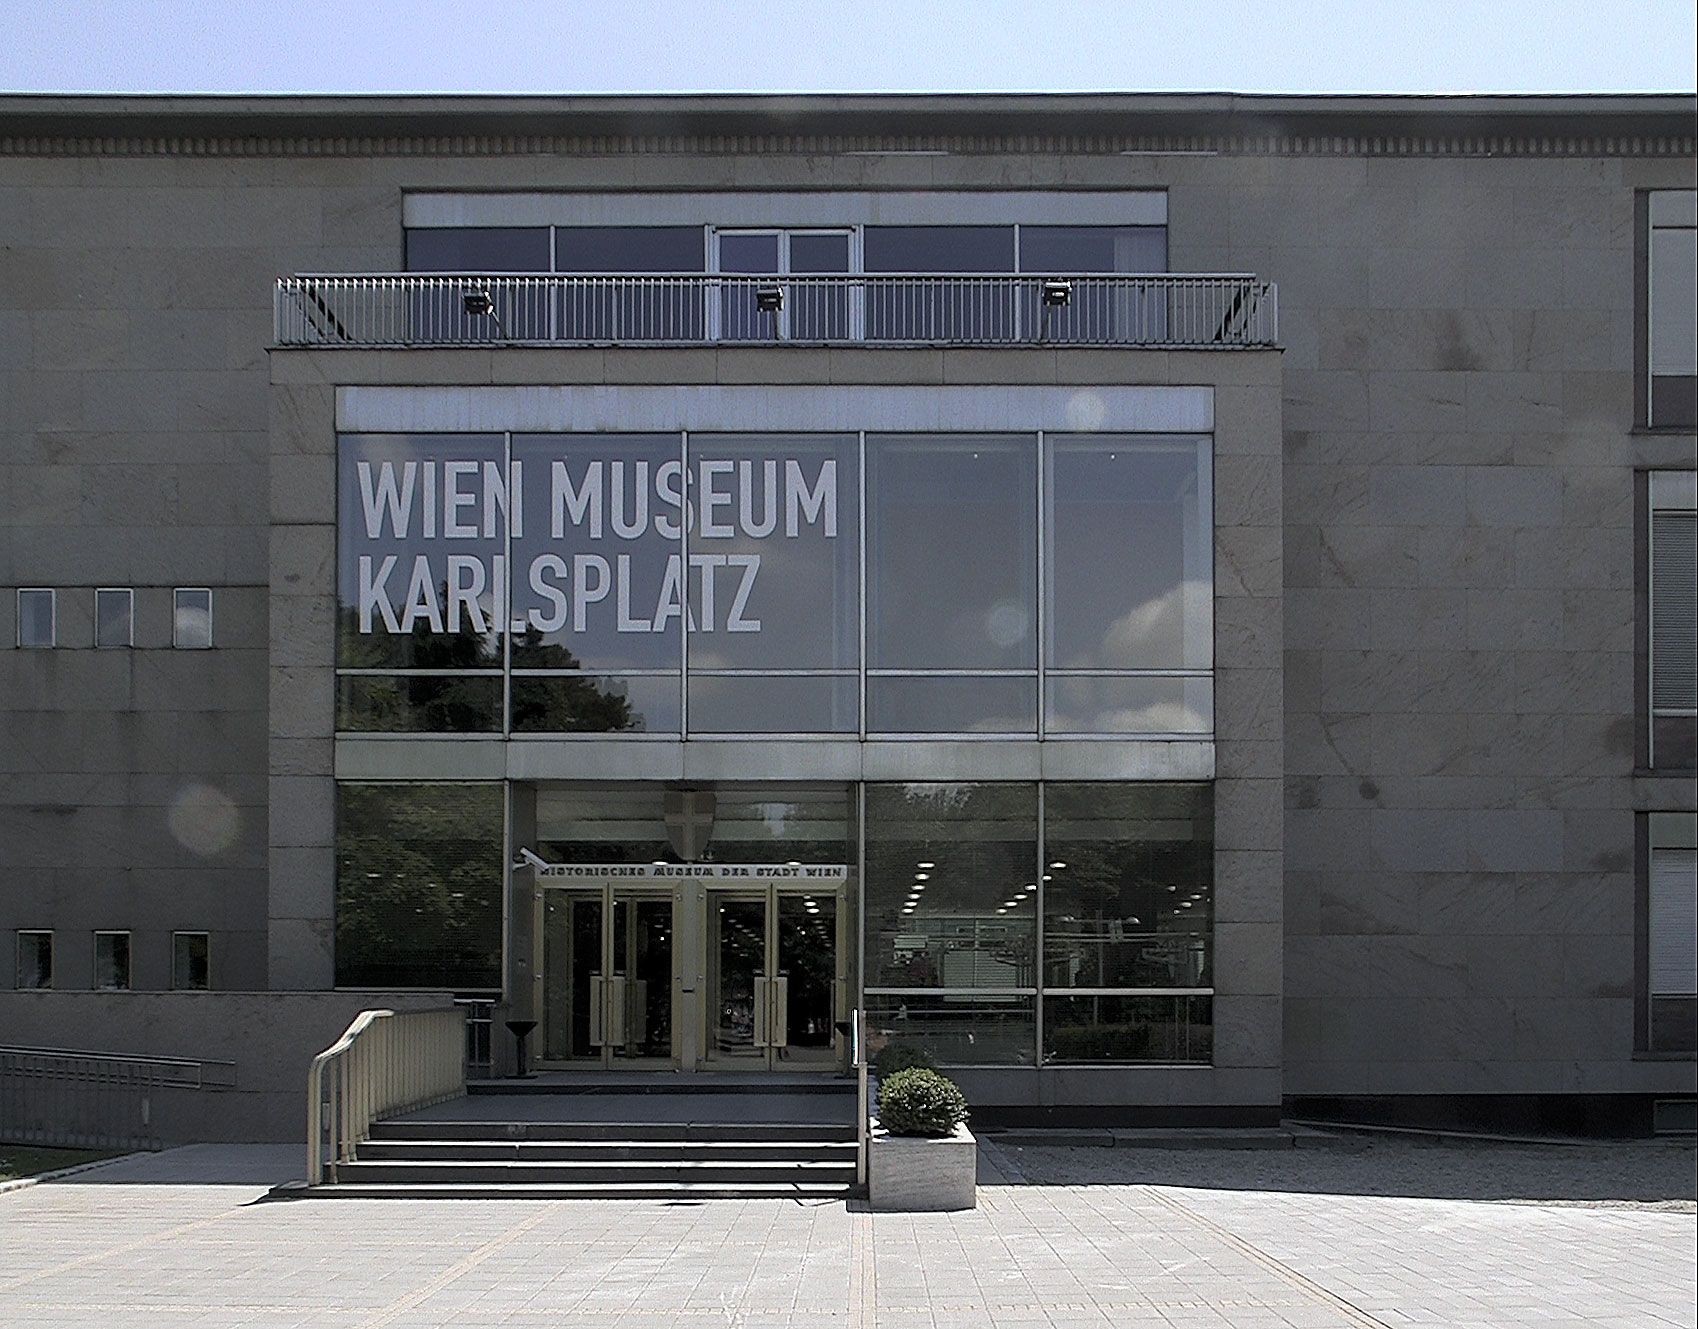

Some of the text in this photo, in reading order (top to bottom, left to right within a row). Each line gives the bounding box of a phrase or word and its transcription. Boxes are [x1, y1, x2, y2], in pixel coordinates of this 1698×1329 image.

[357, 460, 837, 539] WIEN MUSEUM
[358, 554, 761, 633] KARLSPLATZ
[653, 867, 714, 876] MUSEUM
[721, 867, 750, 876] DER
[756, 867, 800, 877] STADT
[805, 867, 842, 877] WIEN
